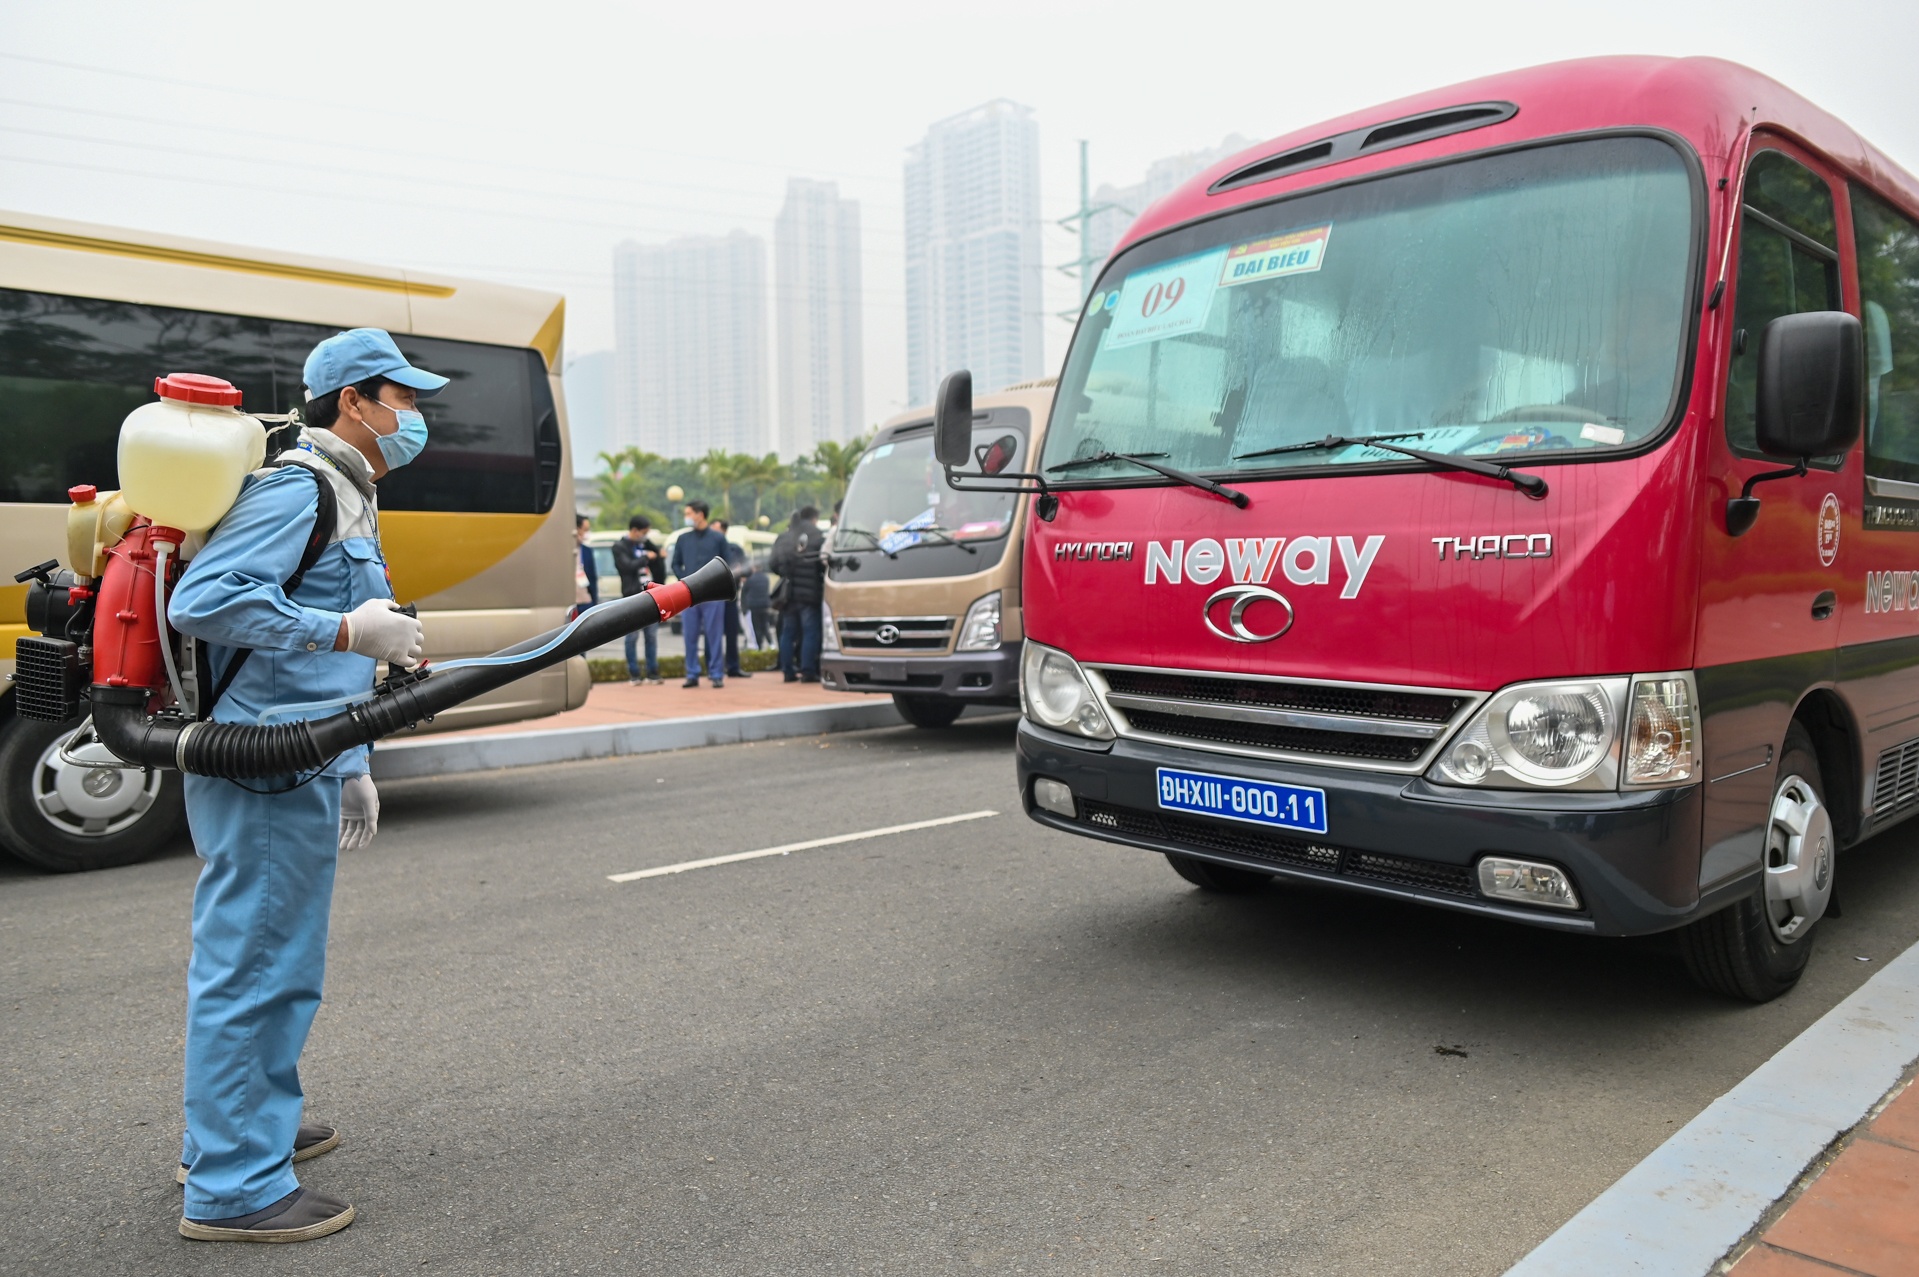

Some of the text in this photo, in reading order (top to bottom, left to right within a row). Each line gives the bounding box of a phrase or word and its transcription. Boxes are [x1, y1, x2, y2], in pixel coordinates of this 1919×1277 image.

[1141, 276, 1186, 319] 09
[1054, 541, 1135, 562] HYUNDAI
[1431, 532, 1553, 561] THACO
